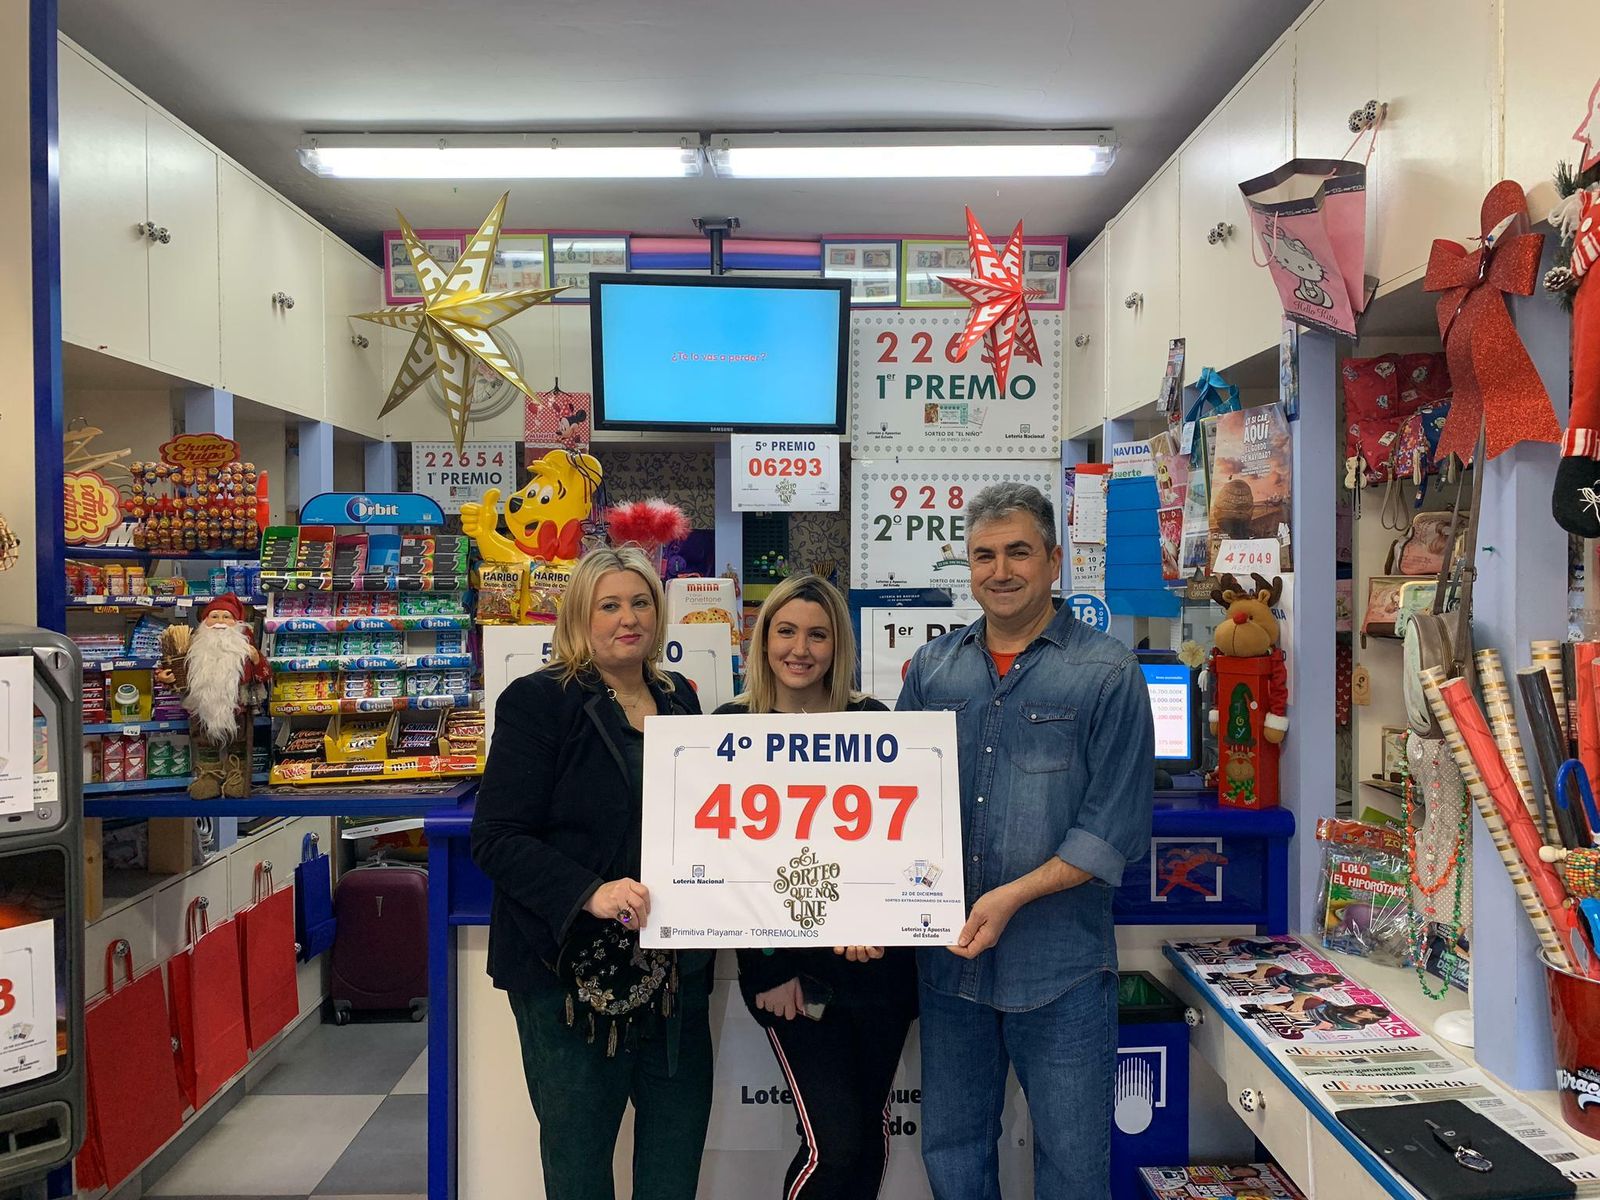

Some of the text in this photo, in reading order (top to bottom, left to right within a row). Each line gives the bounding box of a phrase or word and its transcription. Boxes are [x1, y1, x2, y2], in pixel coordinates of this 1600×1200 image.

[173, 442, 227, 454] Chupa
[771, 441, 816, 451] PREMIO
[172, 451, 226, 465] Chups
[425, 451, 504, 467] 22654
[748, 457, 822, 477] 06293
[441, 472, 502, 485] PREMIO
[1114, 469, 1142, 478] suerte
[80, 484, 108, 533] Chups
[346, 498, 399, 521] Orbit
[1225, 552, 1272, 564] 47049
[483, 572, 518, 582] HARIBO
[285, 619, 316, 631] Orbit
[354, 619, 384, 630] Orbit
[421, 618, 451, 629] Orbit
[357, 657, 387, 669] Orbit
[422, 656, 451, 667] Orbit
[276, 705, 301, 713] sugus
[307, 703, 332, 712] sugus
[360, 701, 387, 711] Orbit
[422, 698, 448, 708] Orbit
[766, 733, 899, 763] PREMIO
[694, 783, 918, 841] 49797
[1341, 863, 1368, 875] LOLO
[774, 863, 840, 894] SORTEO
[1333, 874, 1345, 885] EL
[790, 881, 840, 902] QUE NOS
[784, 899, 827, 927] UNE
[672, 928, 705, 937] Primitiva
[707, 928, 743, 939] Playamar
[750, 929, 819, 938] TORREMOLINOS
